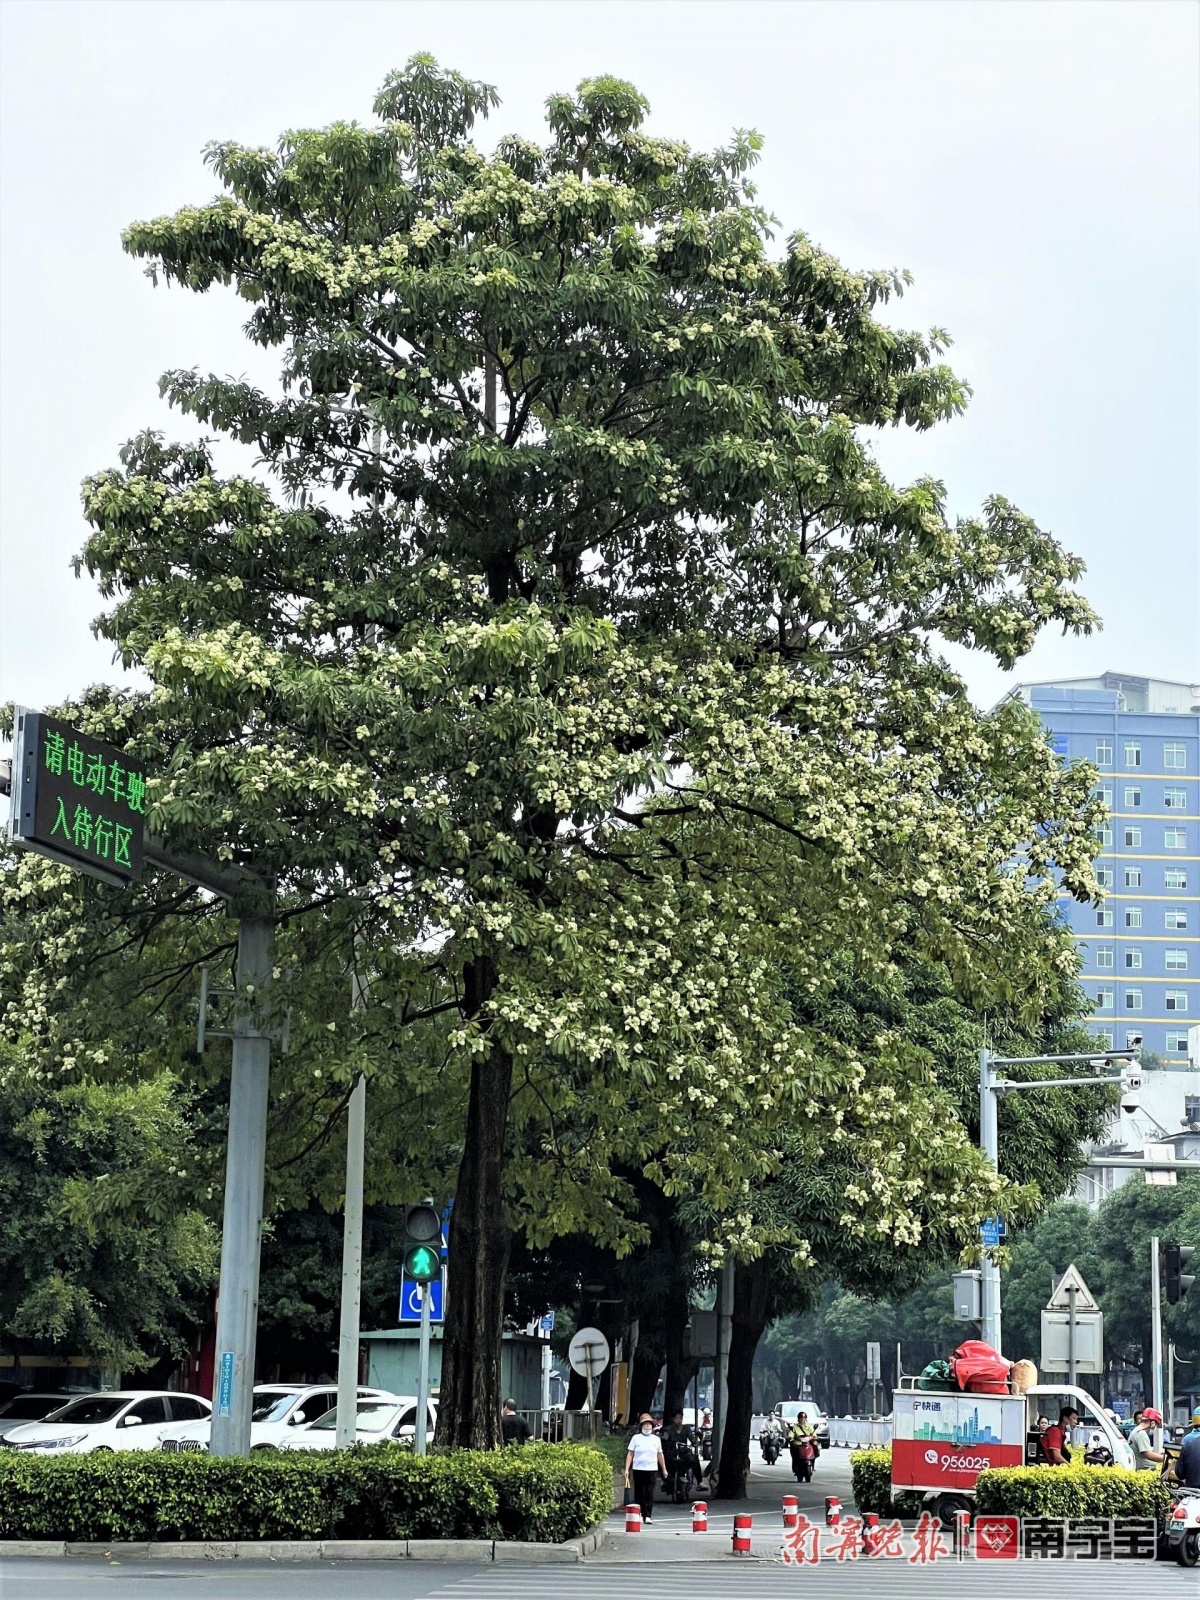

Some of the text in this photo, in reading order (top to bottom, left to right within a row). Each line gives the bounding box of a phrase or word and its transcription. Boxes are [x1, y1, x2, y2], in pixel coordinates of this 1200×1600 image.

[44, 728, 145, 814] 请电动车驶
[50, 796, 133, 868] 入待行区
[941, 1454, 990, 1471] 956025
